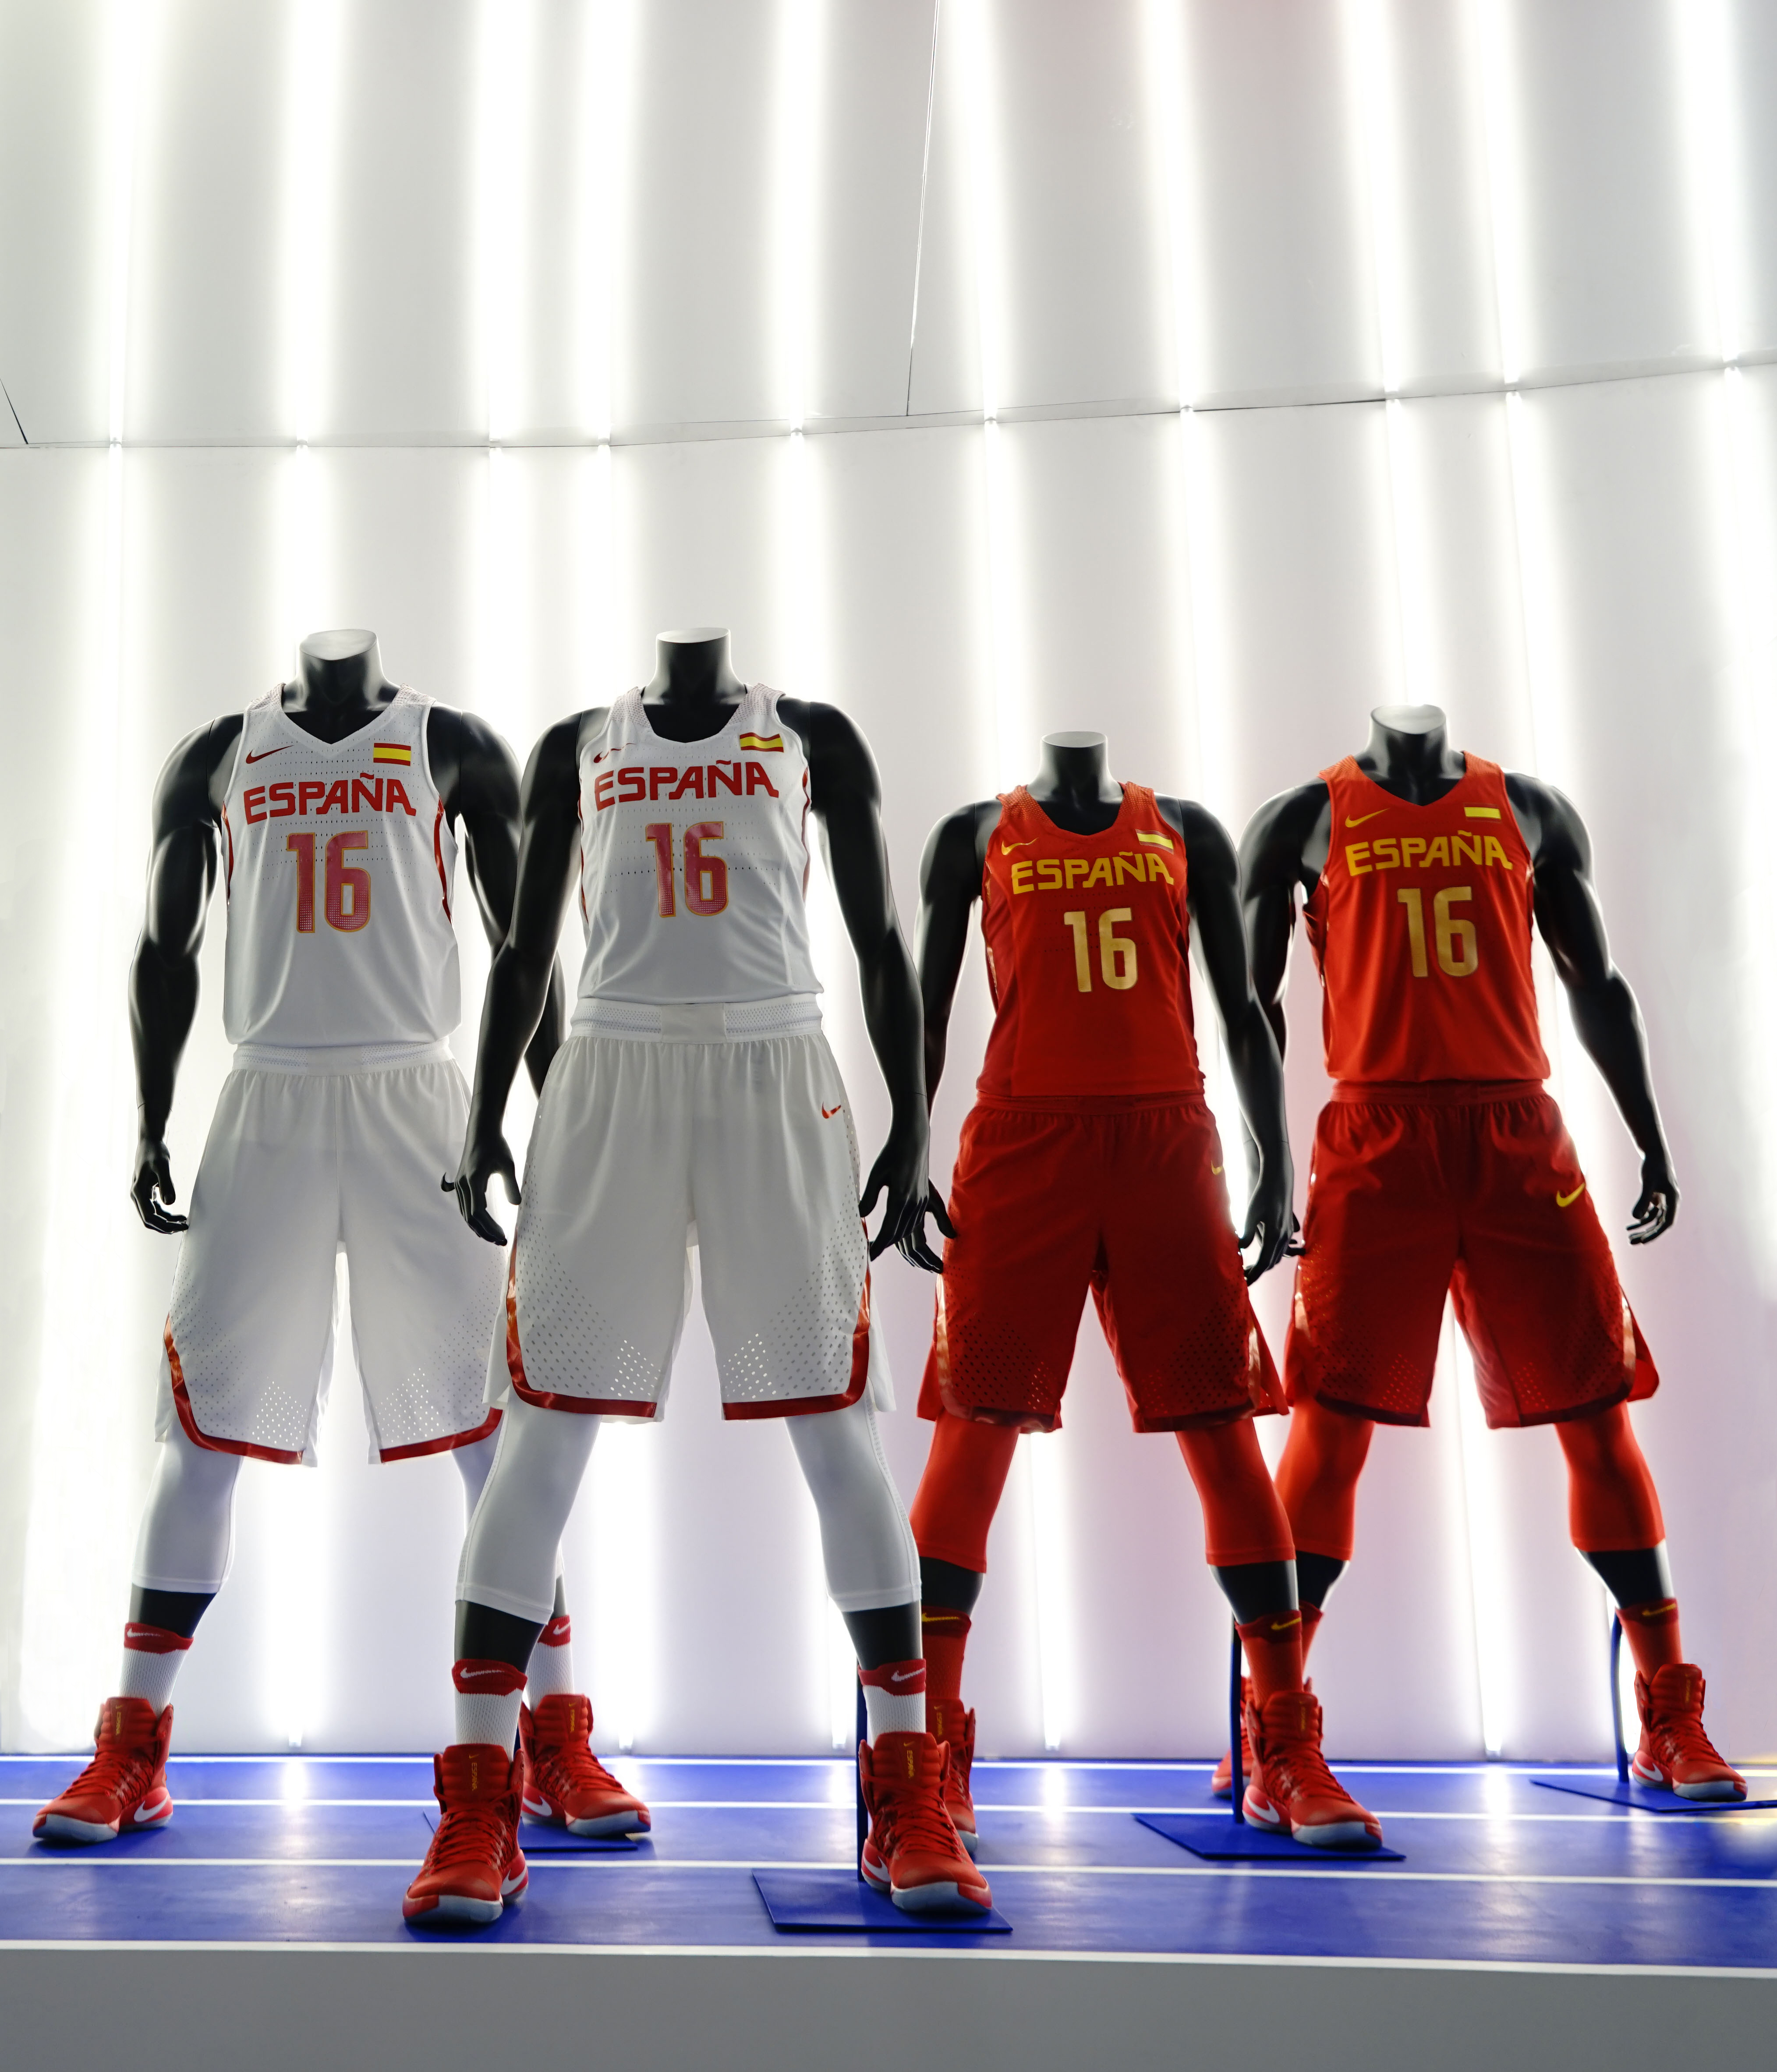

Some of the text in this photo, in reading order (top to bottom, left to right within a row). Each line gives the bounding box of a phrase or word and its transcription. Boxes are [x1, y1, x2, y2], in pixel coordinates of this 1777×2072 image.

[243, 772, 416, 825] ESPAÑA
[594, 760, 779, 811] ESPAÑA
[287, 831, 371, 933] 16
[645, 822, 729, 917] 16
[1011, 851, 1175, 894] ESPAÑA
[1345, 830, 1512, 876] ESPAÑA
[1063, 907, 1138, 993] 16
[1397, 886, 1478, 978] 16
